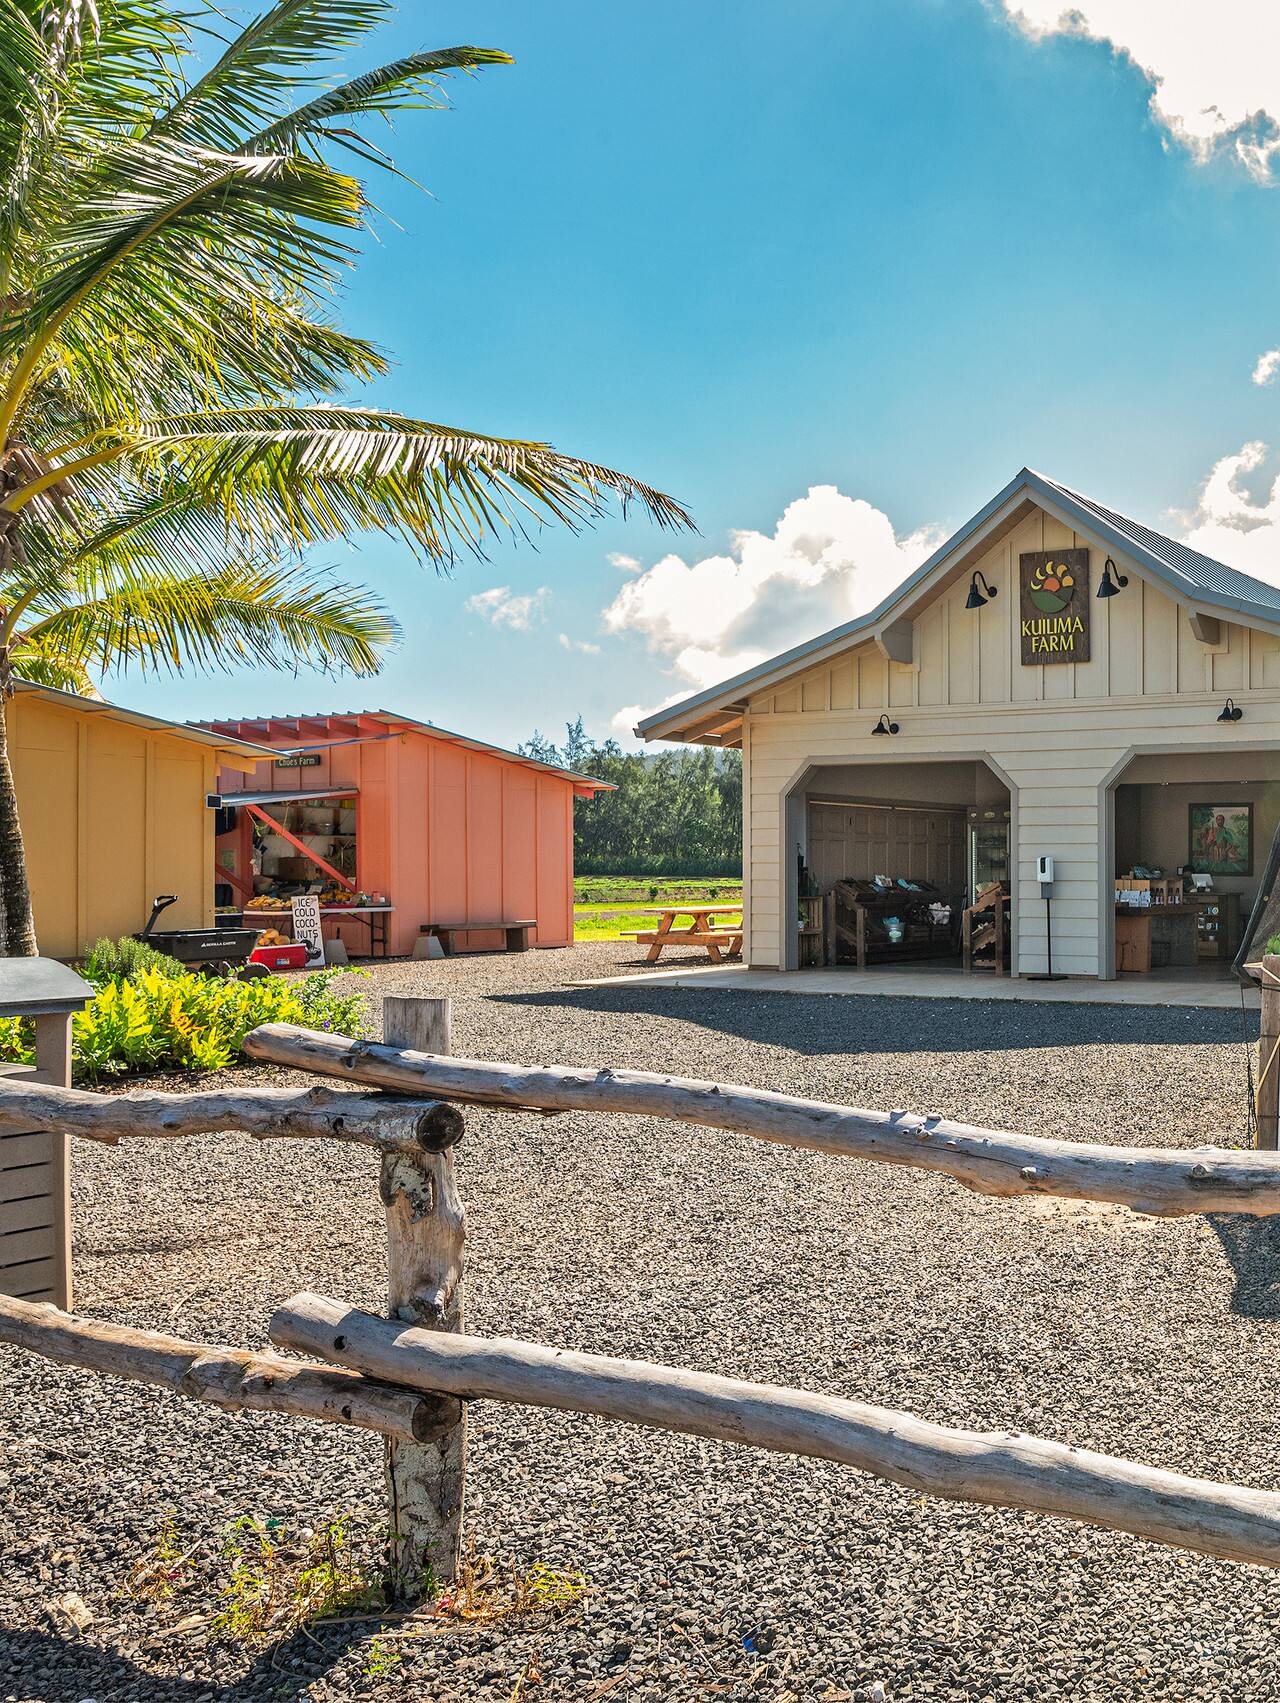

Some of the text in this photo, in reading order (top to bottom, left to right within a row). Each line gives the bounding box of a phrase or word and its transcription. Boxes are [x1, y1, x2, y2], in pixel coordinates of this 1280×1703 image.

[1022, 616, 1084, 637] KUILIMA
[1032, 634, 1074, 653] FARM
[299, 756, 316, 766] Farm
[297, 898, 311, 908] ICE
[294, 907, 316, 918] COLD
[297, 929, 319, 939] NUTS
